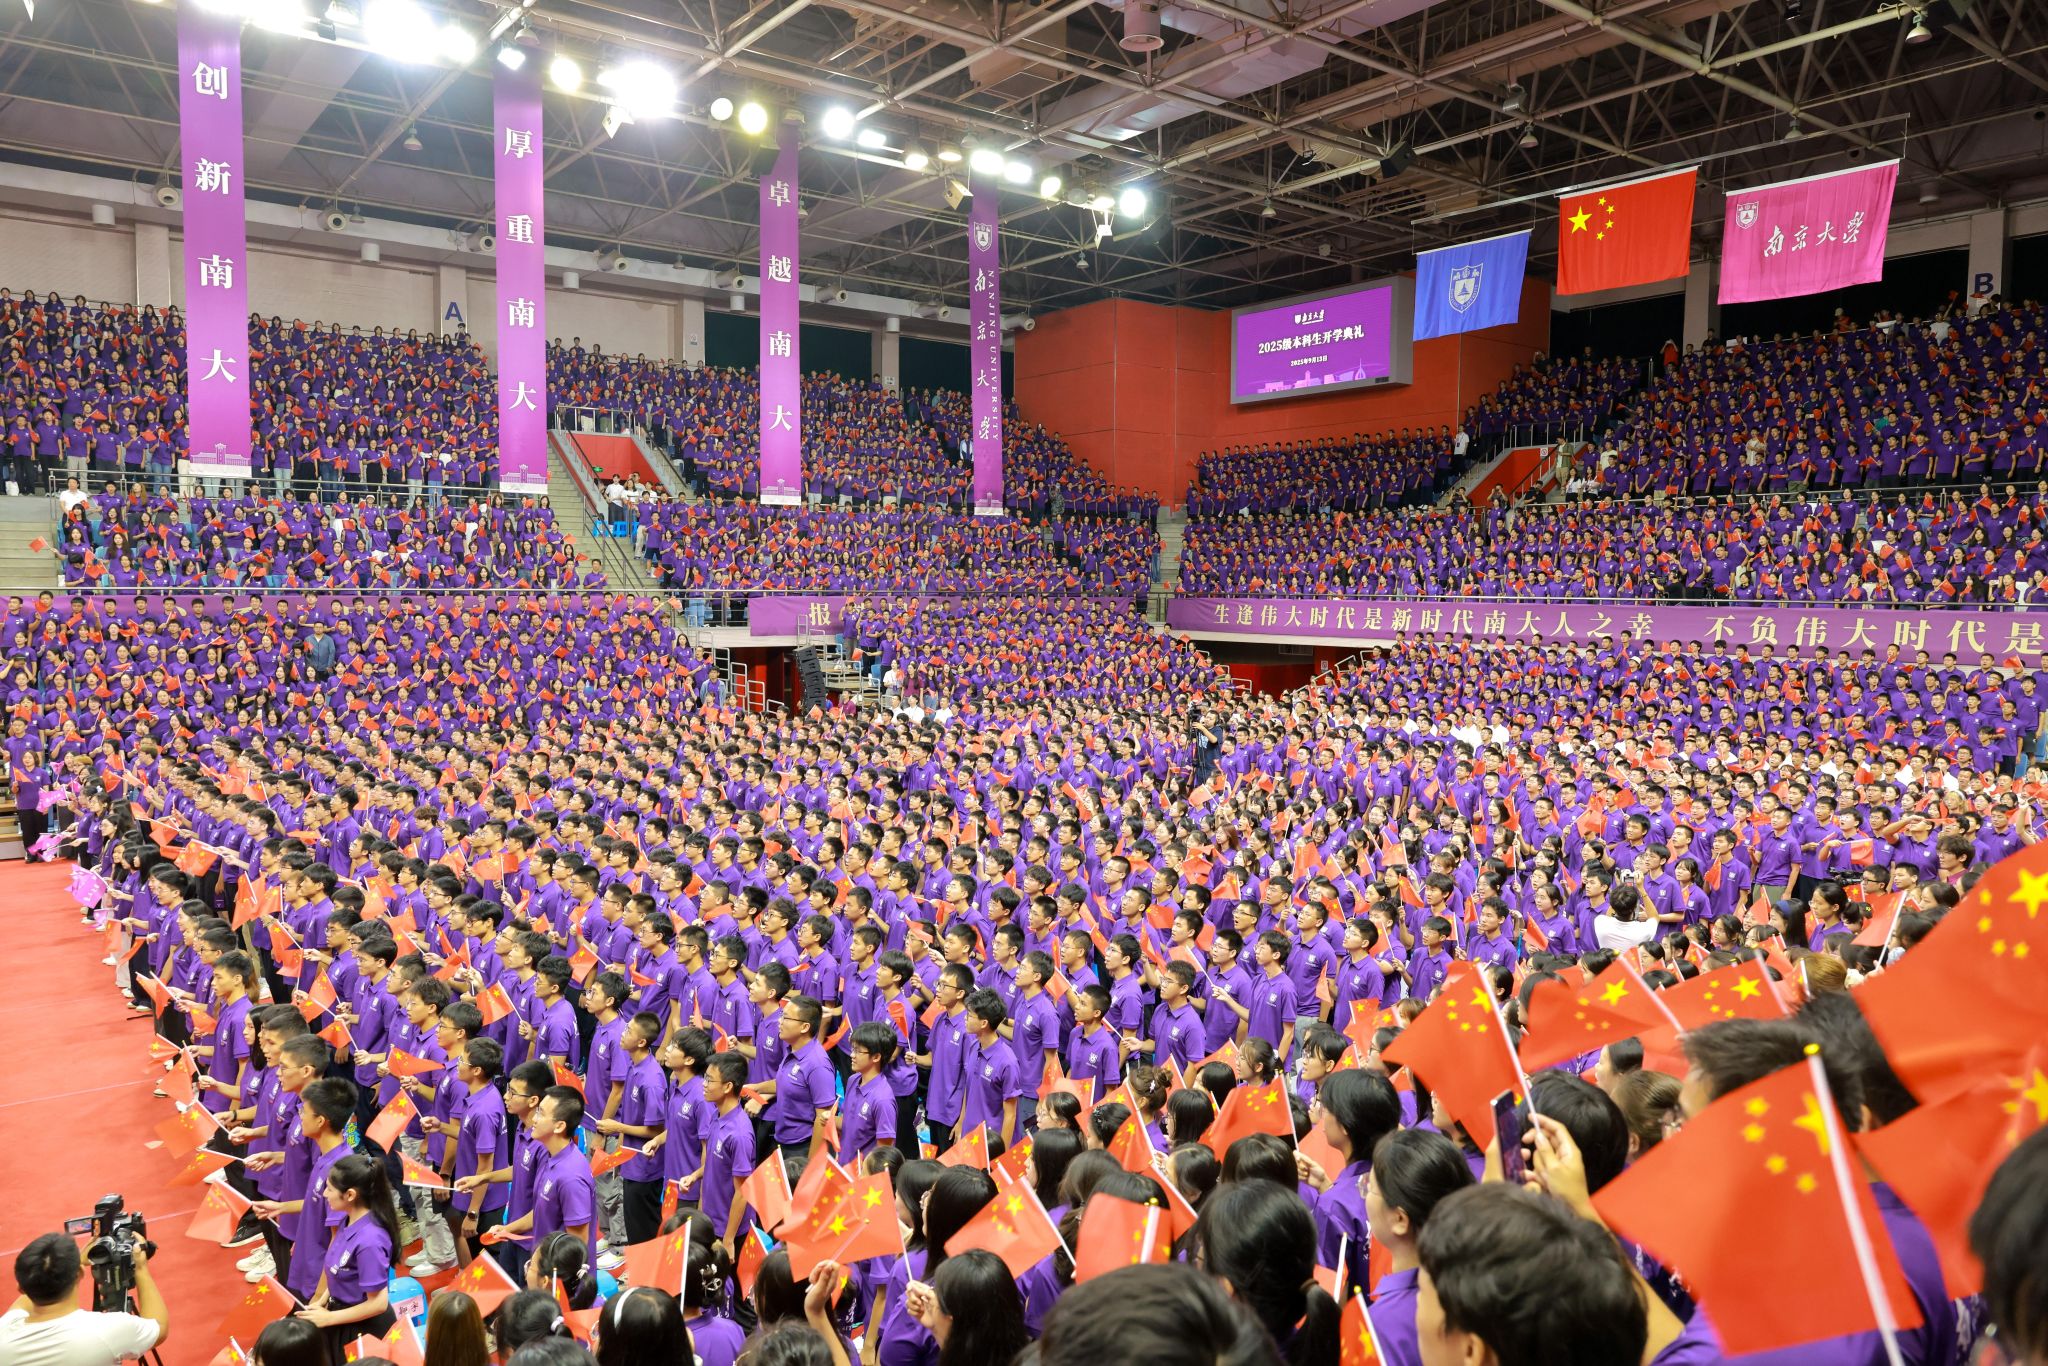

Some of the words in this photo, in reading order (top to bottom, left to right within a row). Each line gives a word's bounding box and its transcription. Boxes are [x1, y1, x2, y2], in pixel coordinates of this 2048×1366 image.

[191, 61, 237, 383] 创新南大
[503, 127, 537, 411] 厚重南大
[1974, 272, 1994, 295] B
[444, 301, 464, 322] A
[767, 180, 793, 432] 卓越南大
[988, 270, 996, 338] NANJING
[1258, 324, 1365, 354] 2025级本科生开学典礼
[1290, 355, 1328, 367] 2025年9月13日
[990, 346, 999, 440] UNIVERSITY
[1213, 603, 1655, 640] 生逢伟大时代是新时代南大人之幸
[1704, 614, 2046, 654] 不负伟大时代是
